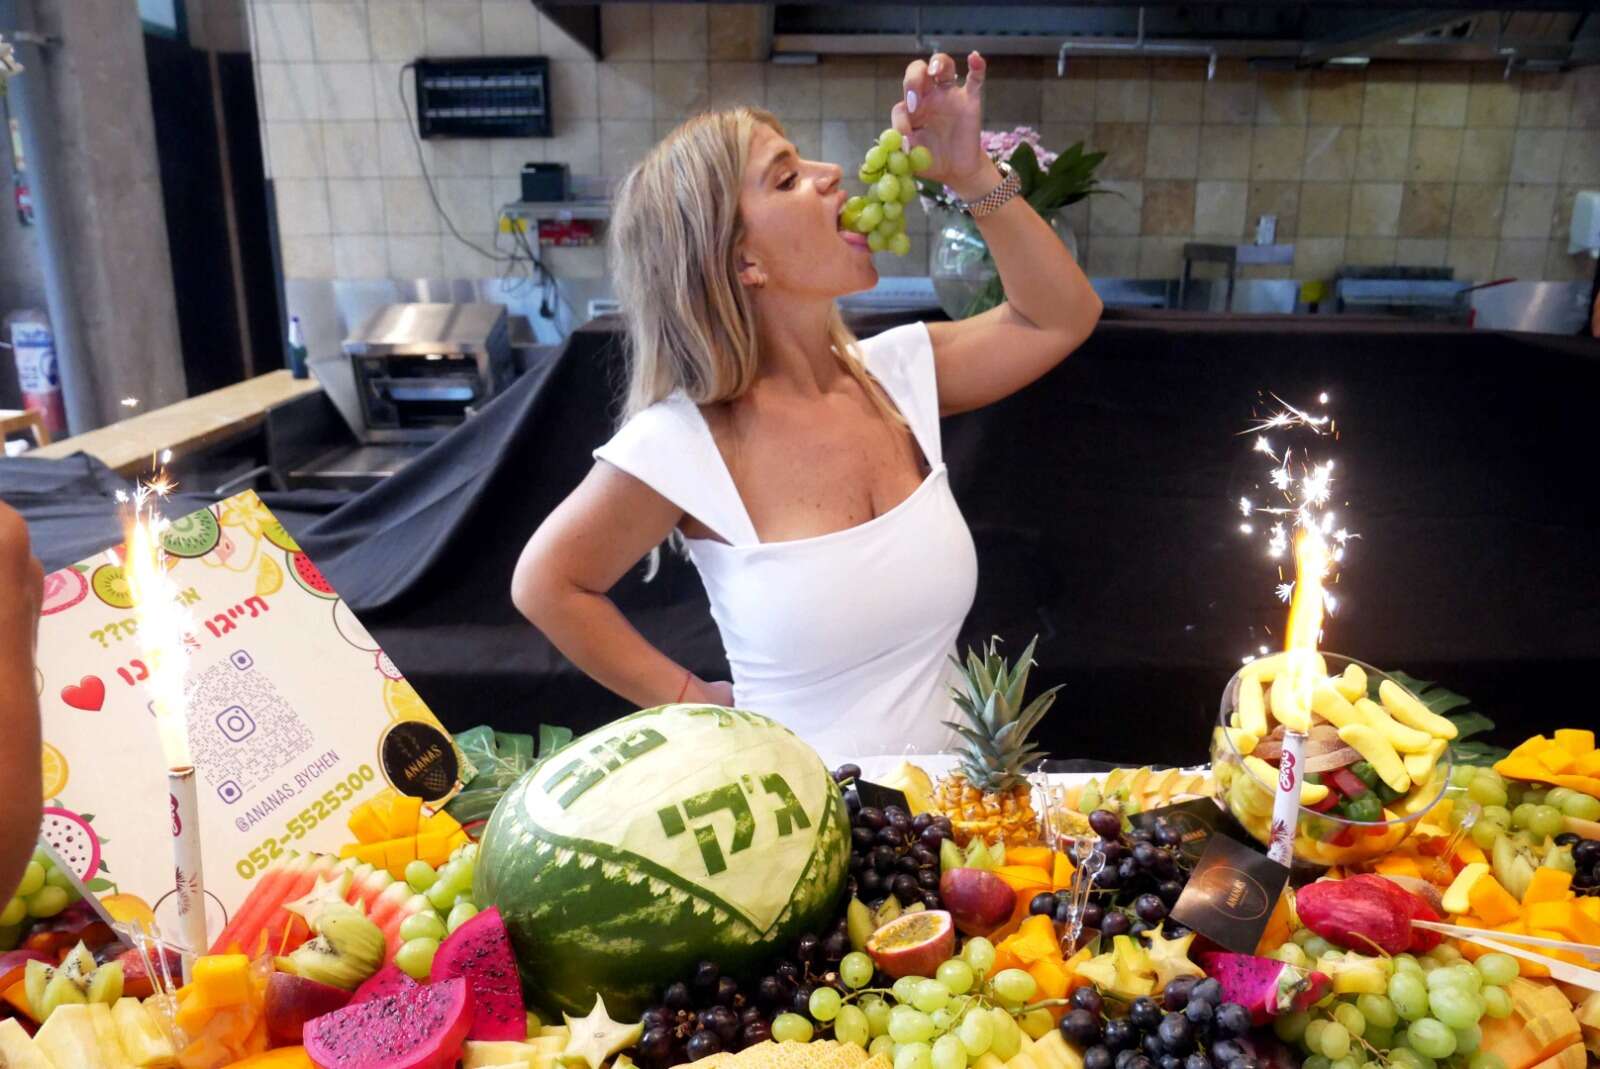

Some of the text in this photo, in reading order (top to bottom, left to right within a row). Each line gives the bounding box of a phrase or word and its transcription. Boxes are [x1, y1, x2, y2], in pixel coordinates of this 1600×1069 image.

[205, 595, 269, 638] תייגו
[235, 749, 340, 832] @ANANAS_BYCHEN
[404, 744, 442, 781] ANANAS
[236, 764, 375, 880] 052-5525300
